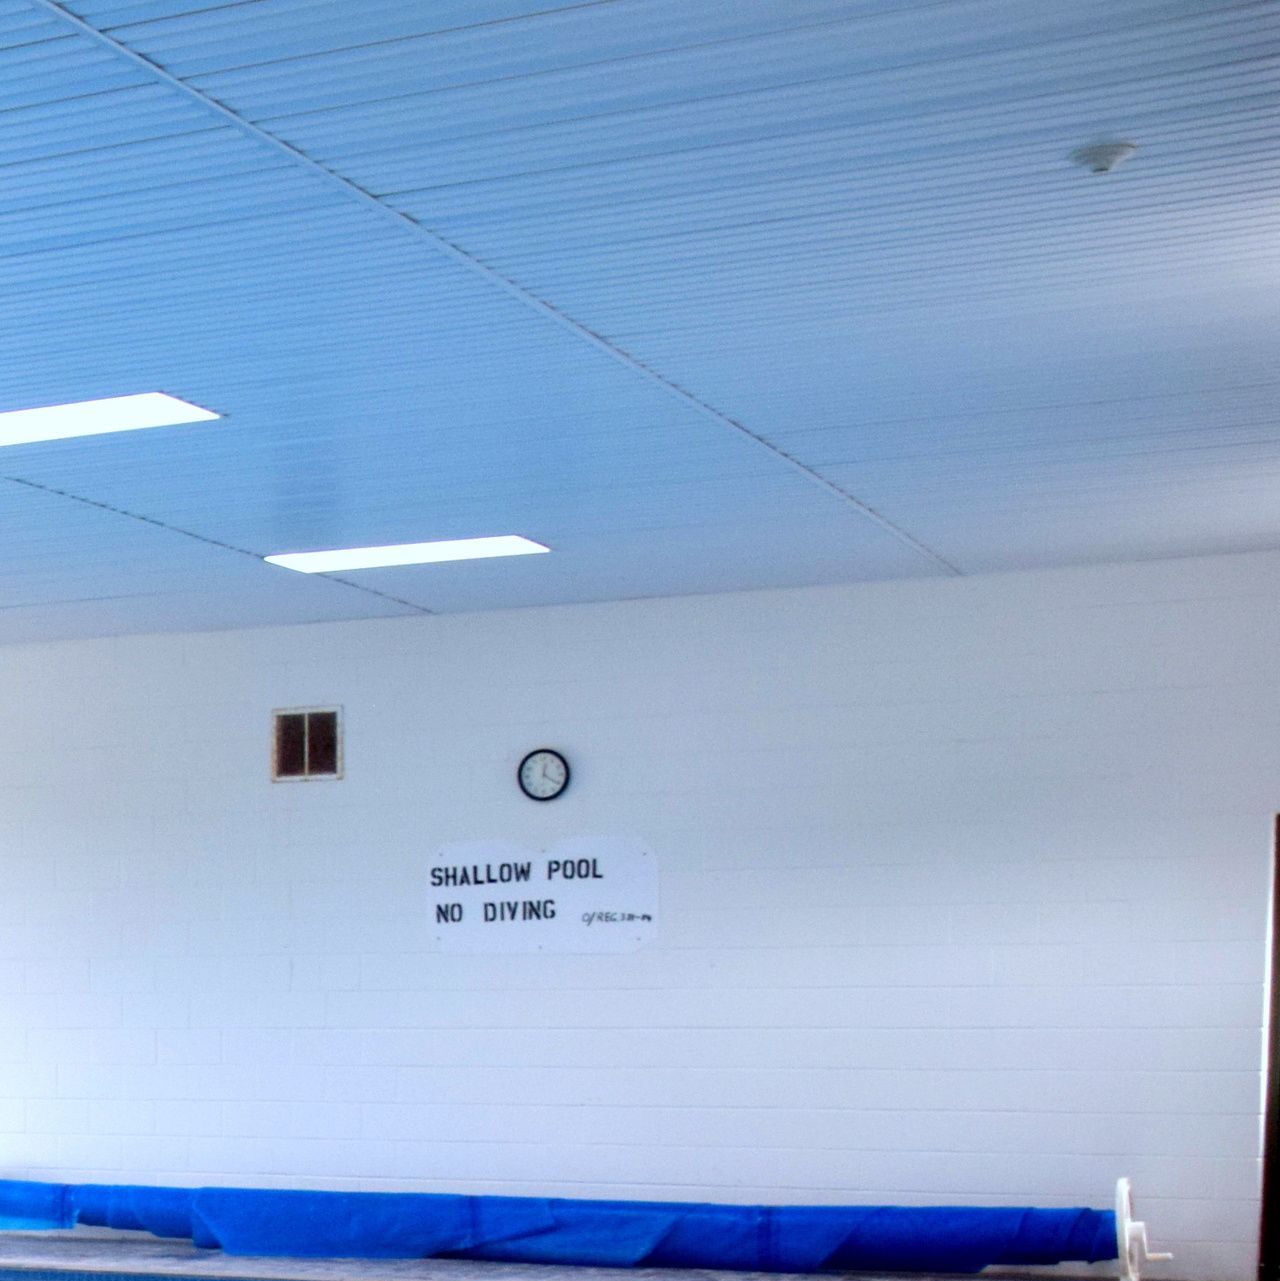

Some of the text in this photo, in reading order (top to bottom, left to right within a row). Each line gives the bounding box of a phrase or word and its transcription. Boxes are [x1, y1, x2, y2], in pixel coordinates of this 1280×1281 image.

[430, 858, 603, 887] SHALLOW POOL
[436, 900, 556, 923] NO DIVING
